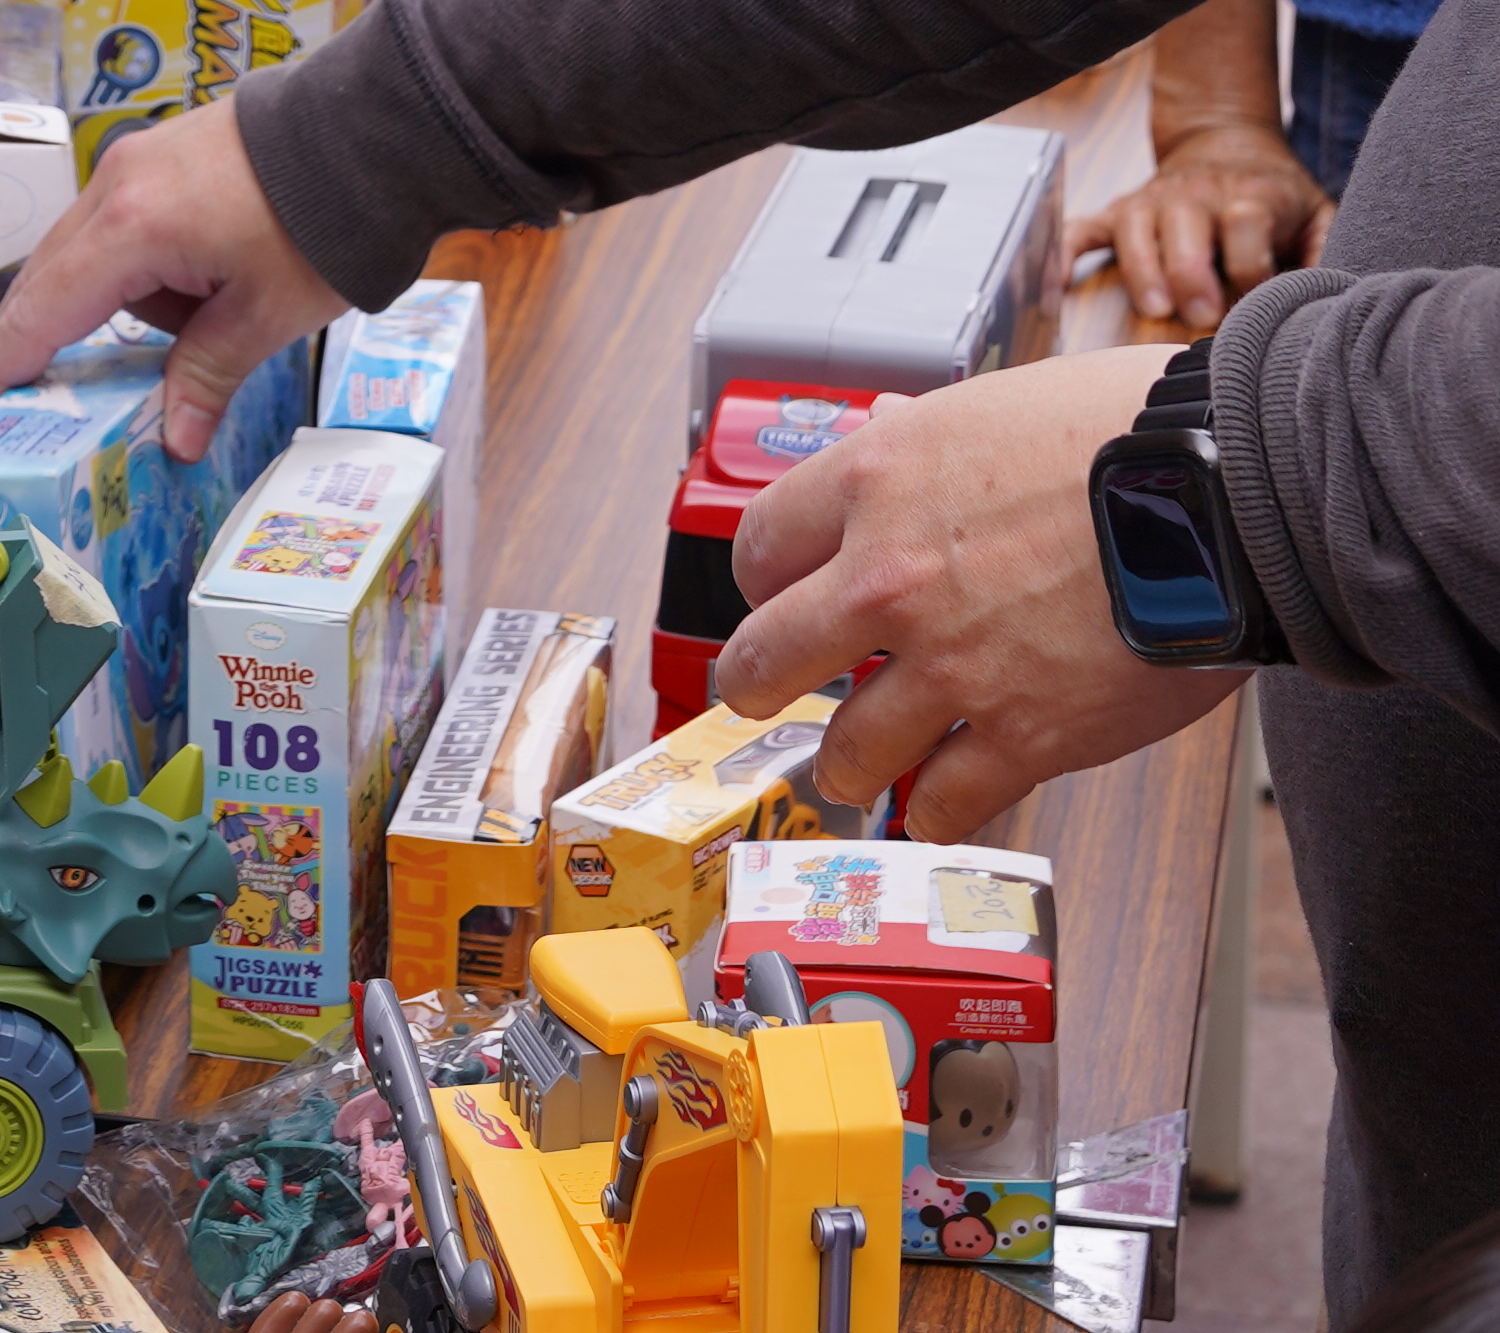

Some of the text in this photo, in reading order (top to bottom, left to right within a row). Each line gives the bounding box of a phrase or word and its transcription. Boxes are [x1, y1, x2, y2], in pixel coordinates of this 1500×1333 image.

[218, 654, 315, 685] Winnie
[234, 681, 304, 710] Pooh
[409, 611, 538, 825] ENGINEERING SERIES
[213, 718, 321, 773] 108
[217, 770, 319, 794] PIECES
[579, 751, 703, 811] TRUCK
[570, 857, 606, 874] NEW
[391, 845, 450, 1001] RUCK
[213, 955, 302, 990] JIGSAW
[229, 975, 318, 999] PUZZLE
[959, 997, 1023, 1014] 吹起即跑
[4, 1293, 44, 1322] COME
